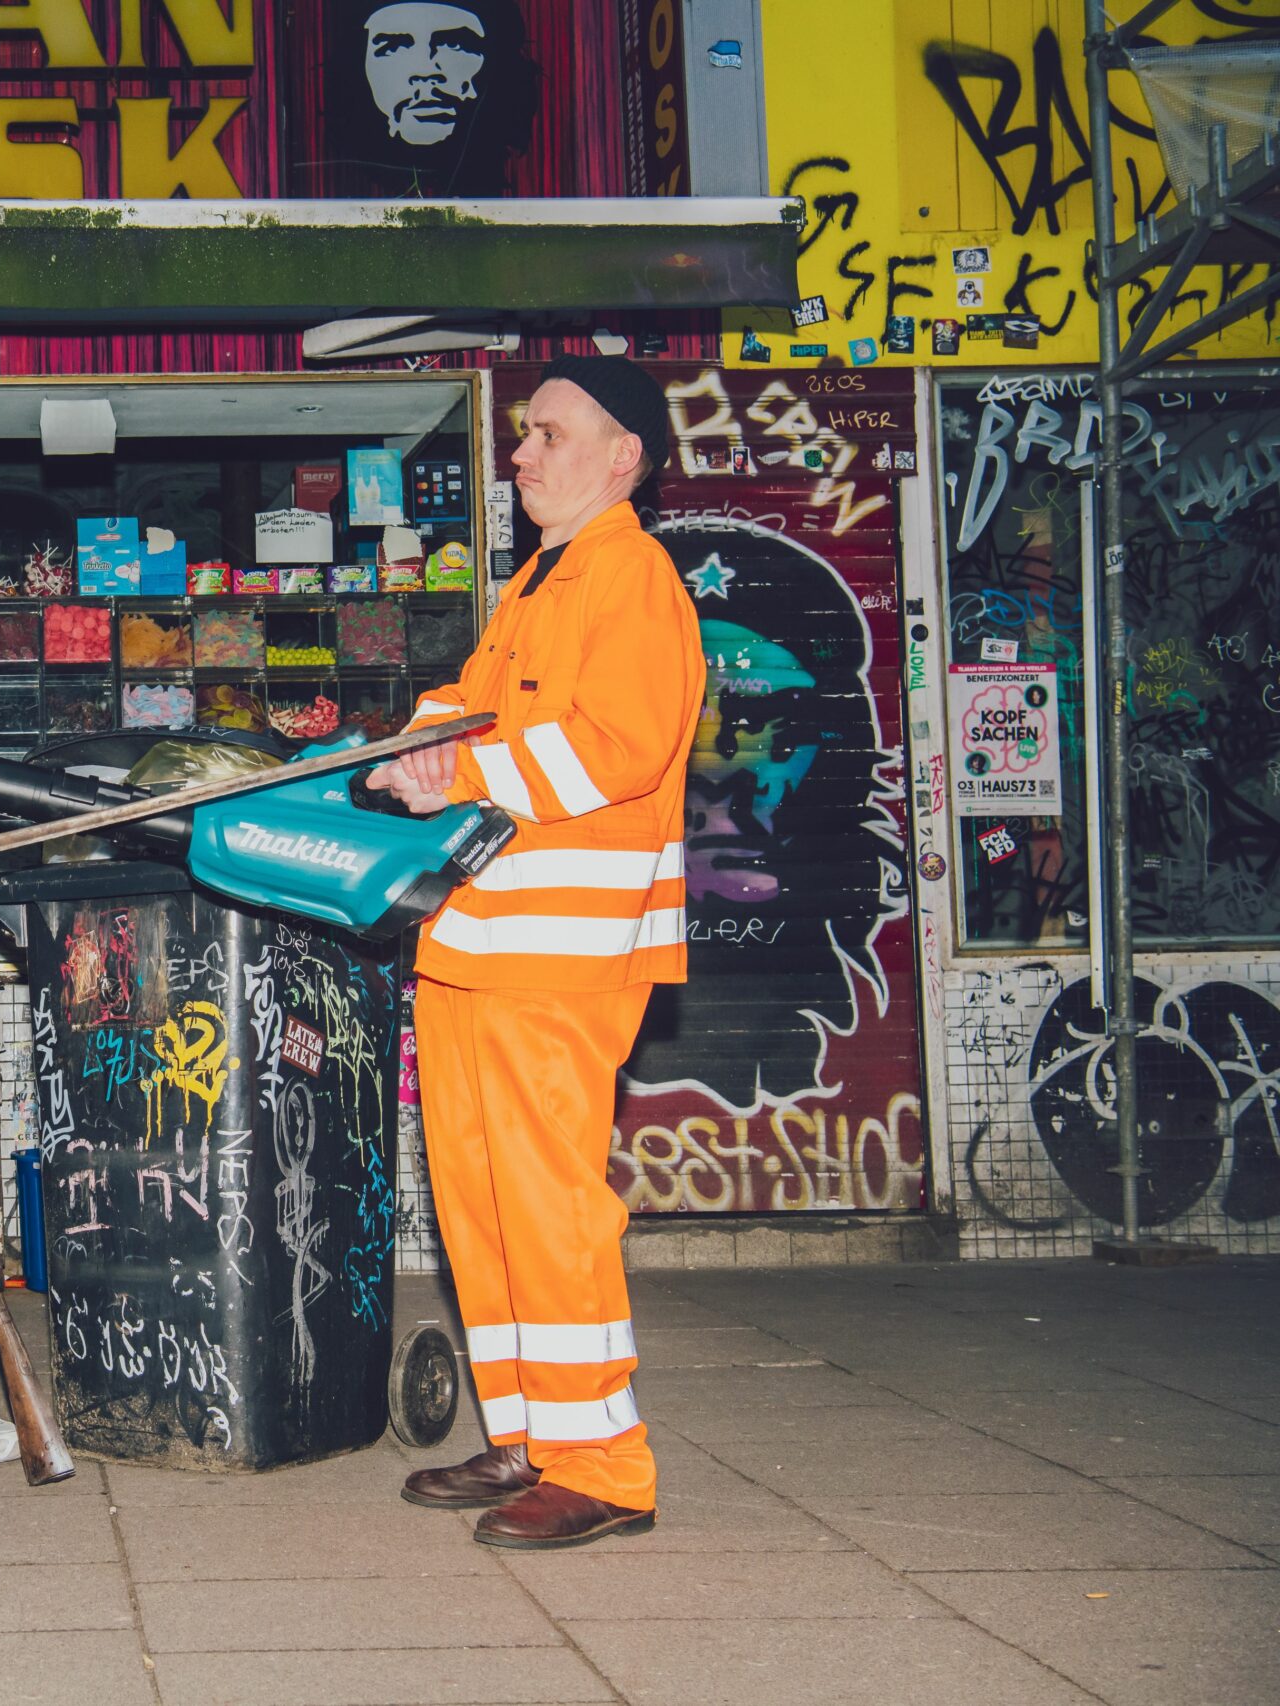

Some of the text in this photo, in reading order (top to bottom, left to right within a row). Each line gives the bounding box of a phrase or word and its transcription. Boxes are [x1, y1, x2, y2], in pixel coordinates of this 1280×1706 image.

[795, 308, 824, 327] CREW
[302, 471, 336, 483] meray
[966, 674, 1040, 682] BENEFIZKONZERT
[981, 710, 1027, 725] KOPF
[971, 726, 1038, 742] SACHEN
[980, 828, 1011, 853] FCK
[987, 838, 1016, 862] AFD
[282, 1037, 320, 1074] CREW
